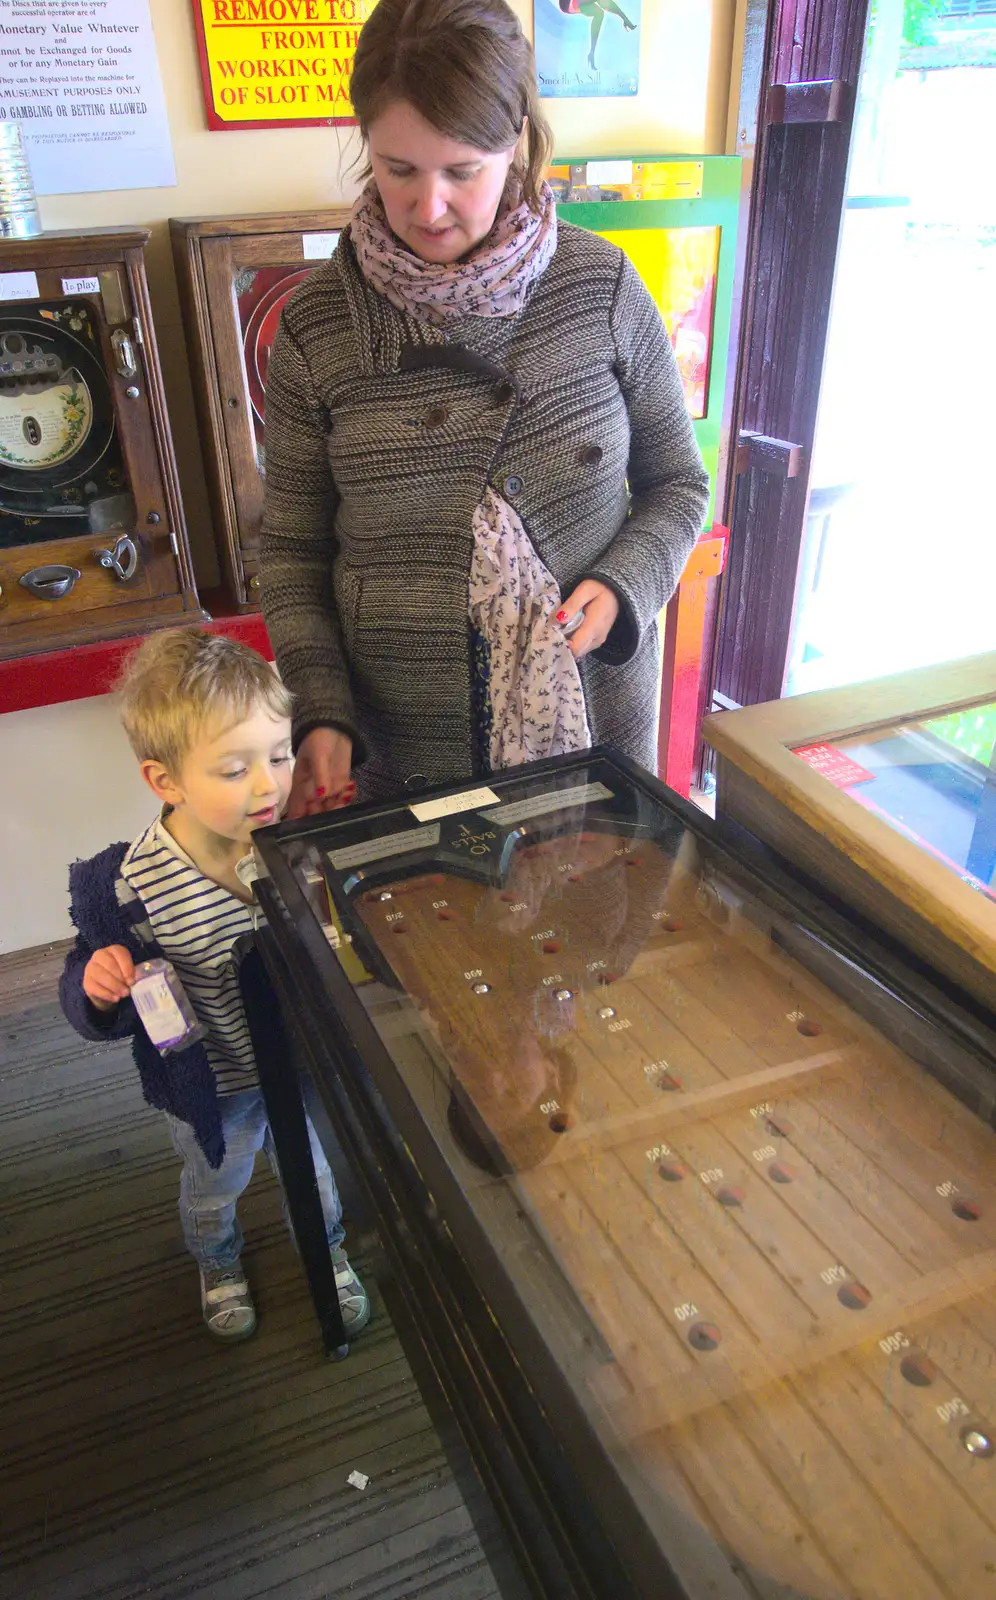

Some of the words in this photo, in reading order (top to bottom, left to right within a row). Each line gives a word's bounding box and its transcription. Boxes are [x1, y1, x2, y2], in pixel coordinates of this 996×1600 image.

[61, 0, 80, 8] given
[213, 0, 319, 21] REMOVE
[47, 9, 75, 17] operator
[52, 23, 83, 34] Value
[87, 23, 139, 34] Whatever
[261, 30, 325, 49] FROM
[329, 30, 359, 49] TH
[25, 47, 36, 55] be
[39, 46, 87, 56] Exchanged
[91, 46, 102, 54] for
[106, 45, 133, 54] Goods
[20, 60, 32, 68] for
[35, 60, 51, 69] any
[54, 58, 95, 68] Monetary
[98, 57, 118, 66] Gain
[217, 58, 326, 79] WORKING
[39, 76, 69, 84] Replayed
[63, 86, 113, 97] PURPOSES
[116, 85, 141, 95] ONLY
[220, 87, 249, 106] OF
[255, 85, 310, 105] SLOT
[316, 84, 351, 102] MA
[10, 104, 53, 119] GAMBLING
[56, 104, 68, 117] OR
[71, 102, 106, 117] BETTING
[109, 102, 148, 115] ALLOWED
[76, 279, 97, 291] play
[451, 832, 497, 847] BALLS
[470, 843, 491, 855] 10
[463, 968, 483, 980] 400
[608, 1018, 632, 1033] 1000
[751, 1143, 777, 1162] 600
[699, 1166, 725, 1185] 400
[878, 1331, 910, 1355] 300
[934, 1397, 971, 1424] 500
